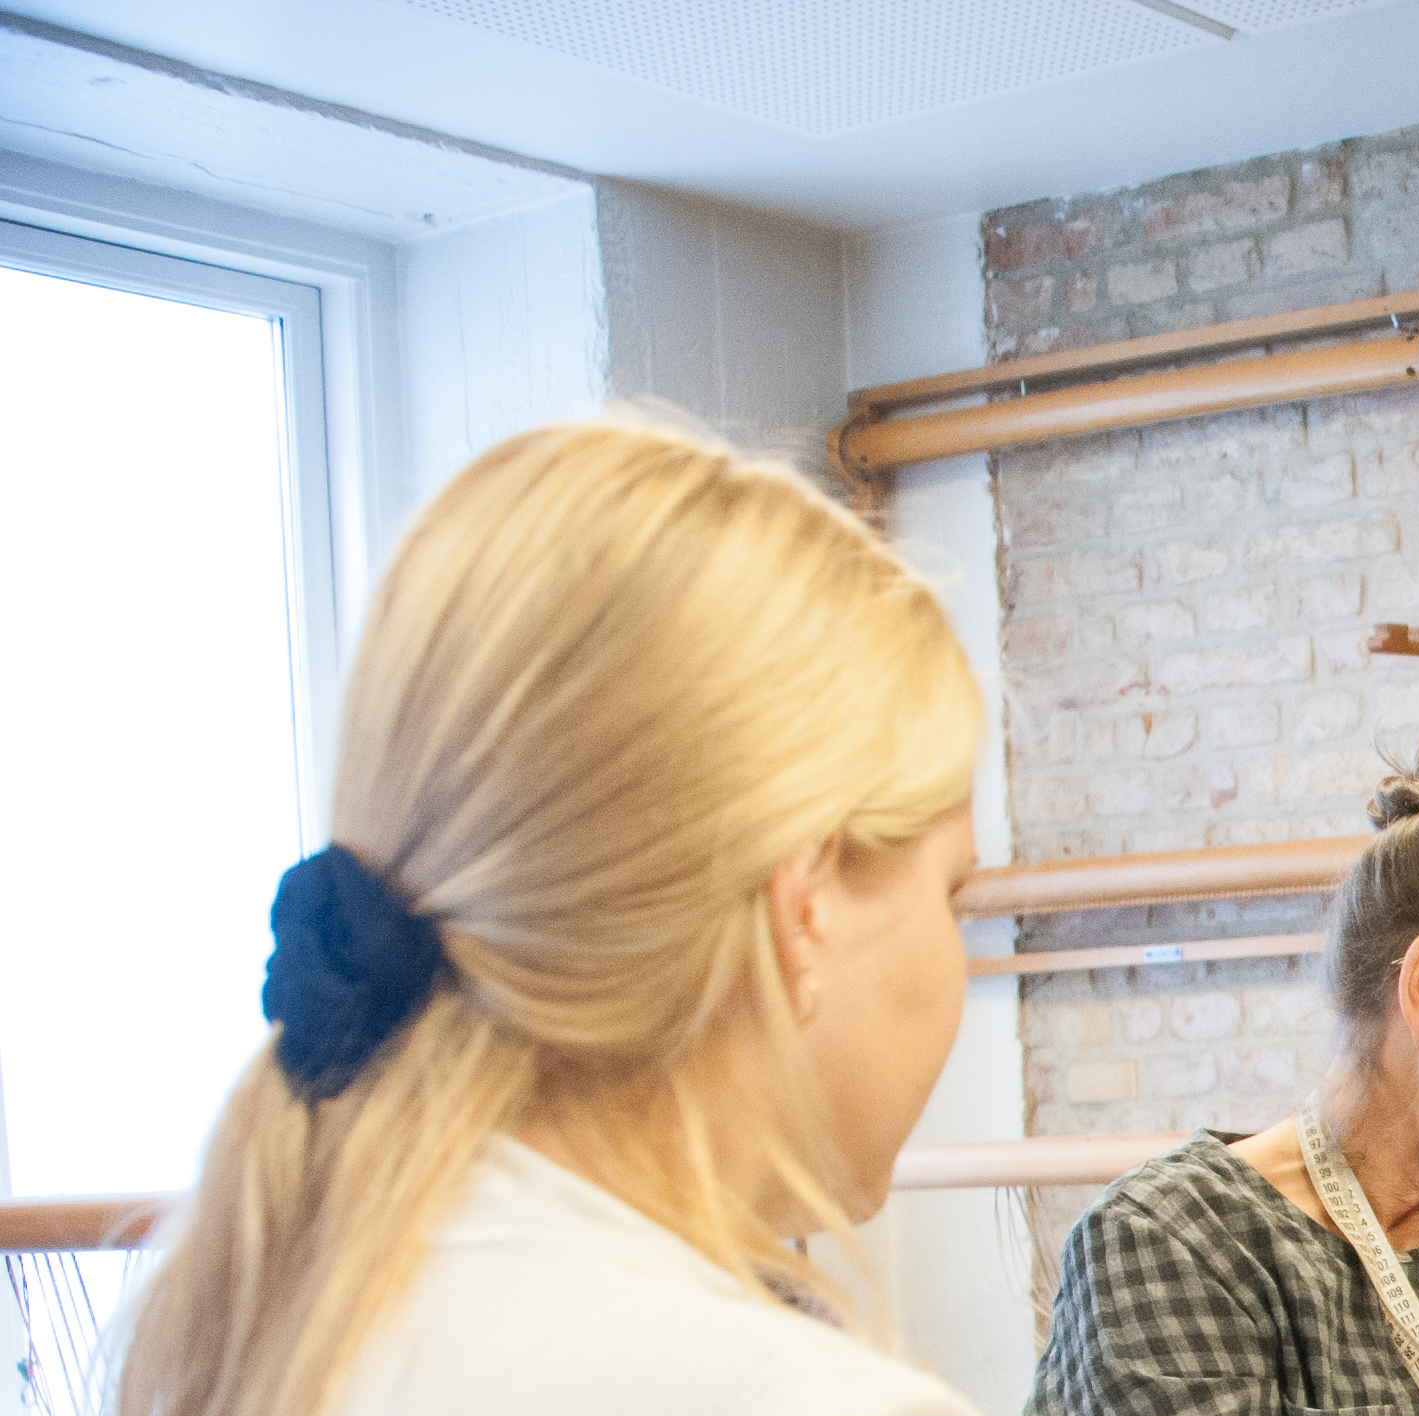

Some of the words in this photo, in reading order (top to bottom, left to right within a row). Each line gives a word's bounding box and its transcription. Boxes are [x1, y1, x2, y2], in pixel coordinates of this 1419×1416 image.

[1319, 1167, 1332, 1178] 99
[1323, 1182, 1340, 1193] 100
[1329, 1196, 1344, 1206] 101
[1386, 1286, 1402, 1300] 109
[1393, 1300, 1410, 1312] 110
[1400, 1312, 1416, 1325] 111
